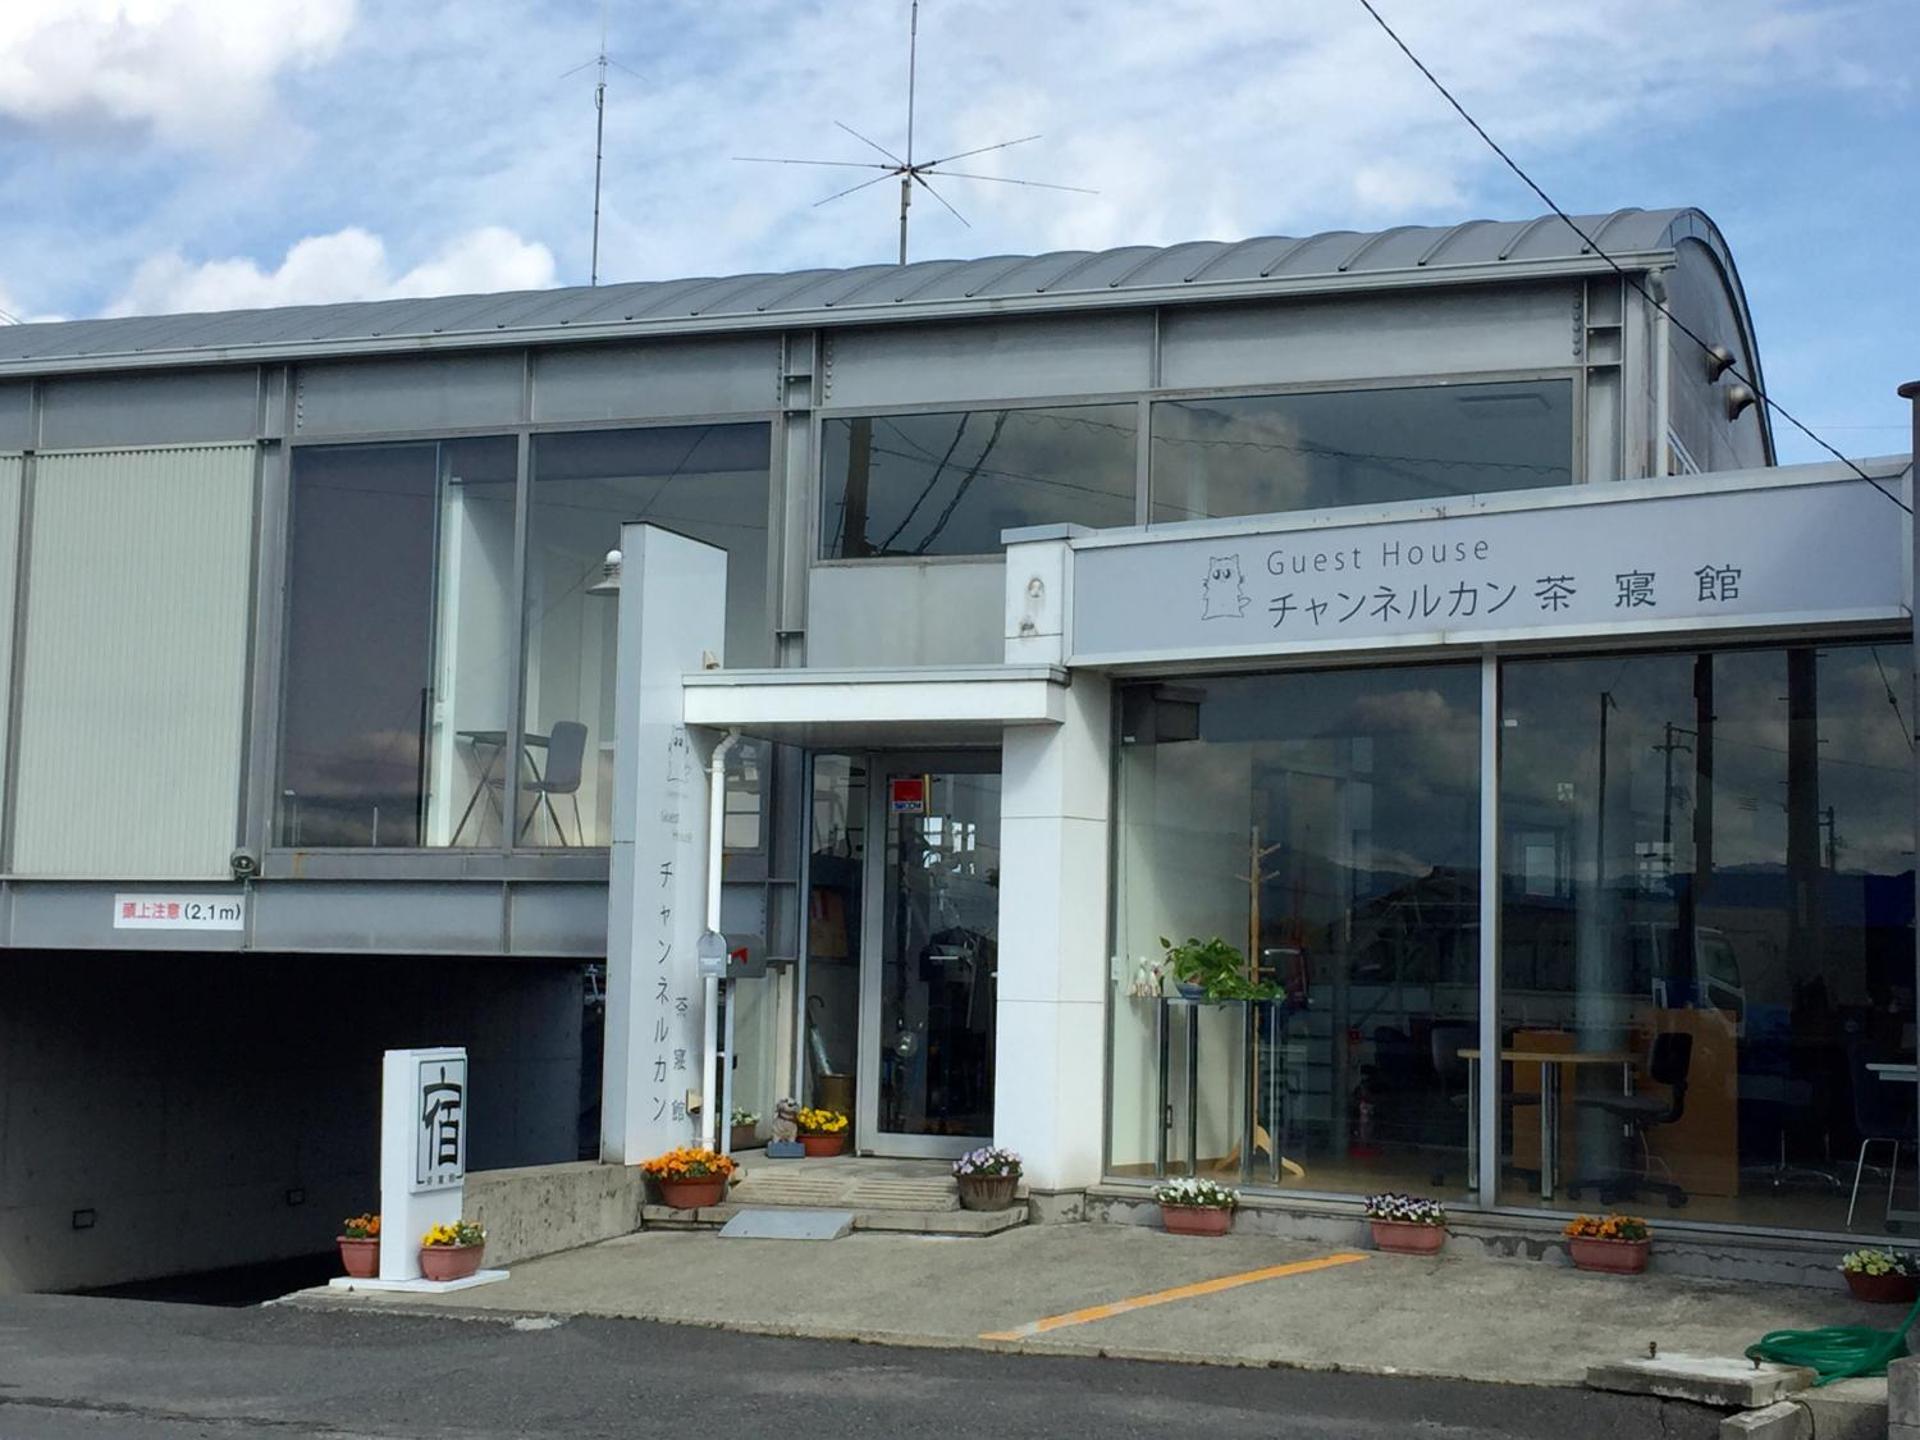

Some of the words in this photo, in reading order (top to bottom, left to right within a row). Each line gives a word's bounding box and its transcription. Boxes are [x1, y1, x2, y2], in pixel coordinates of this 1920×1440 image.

[1267, 547, 1361, 575] Guest
[1382, 540, 1489, 567] House
[1268, 580, 1517, 628] チャンネルカン
[653, 861, 673, 1121] チャンネルカン
[422, 1065, 463, 1171] 宿
